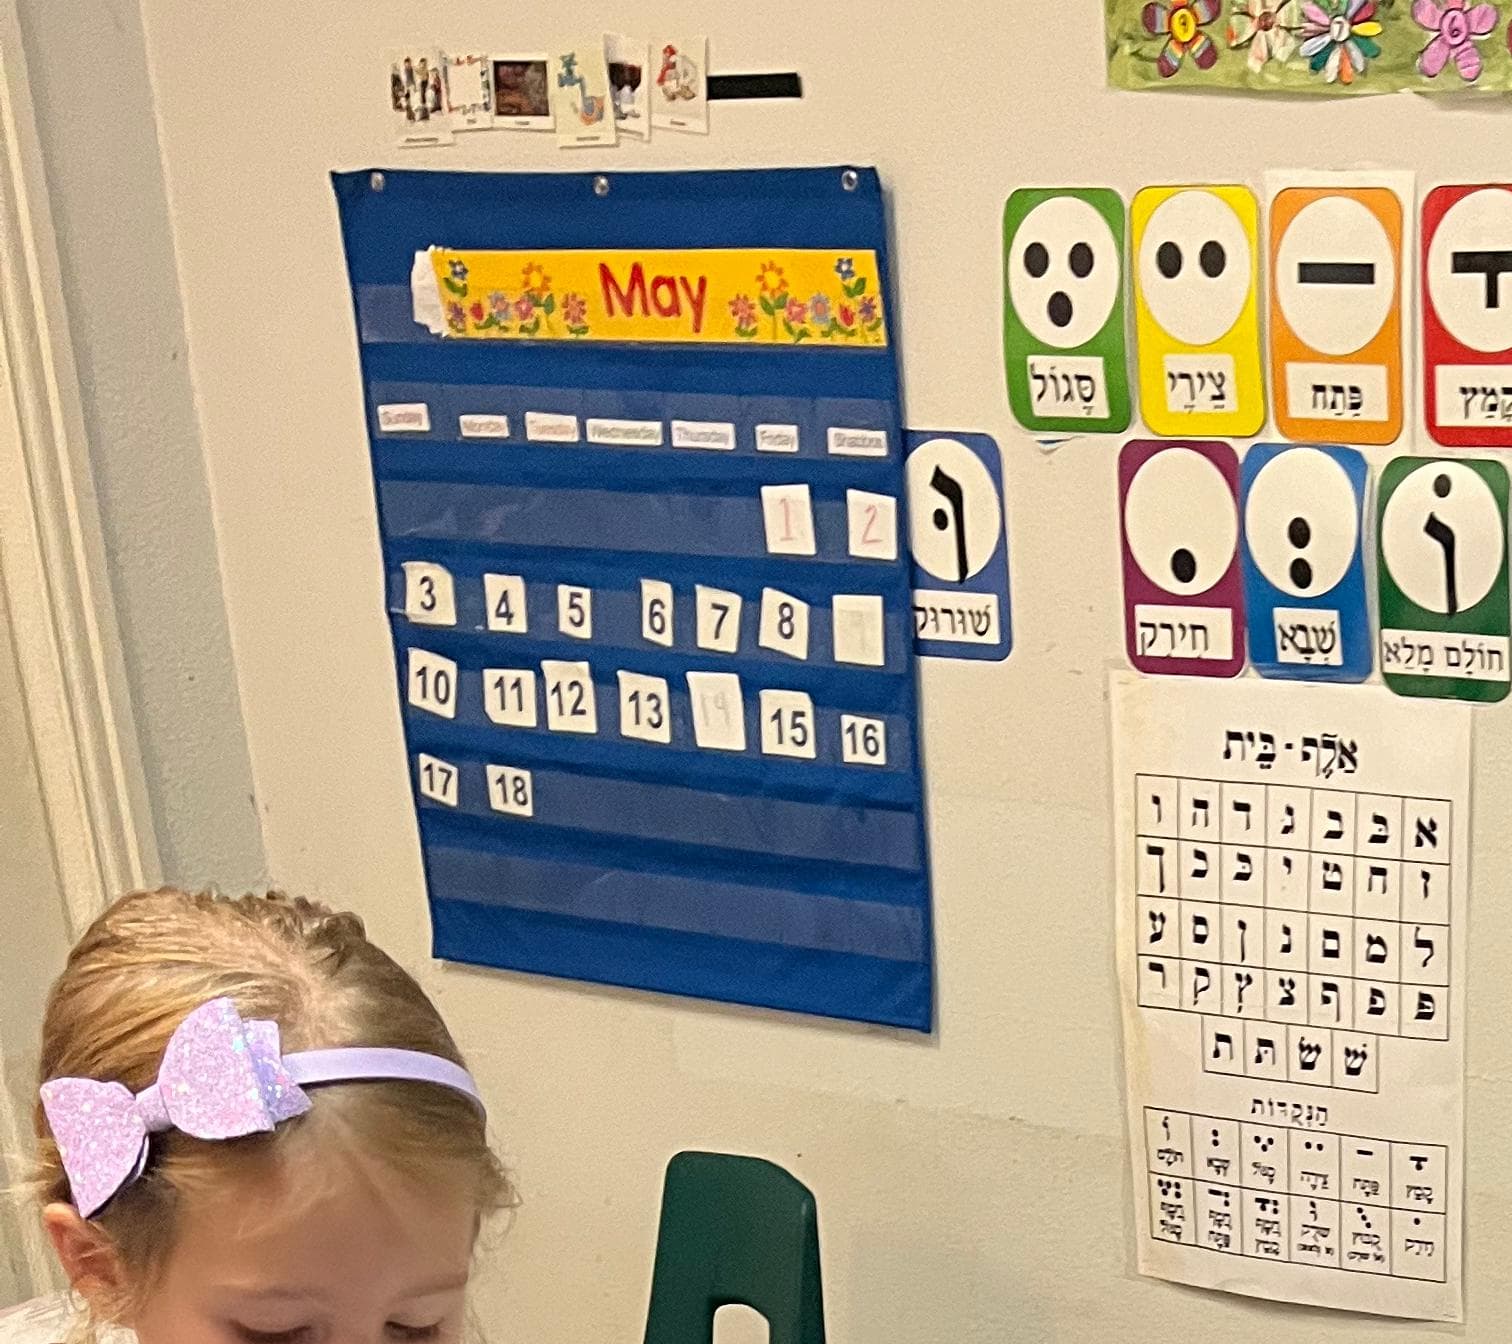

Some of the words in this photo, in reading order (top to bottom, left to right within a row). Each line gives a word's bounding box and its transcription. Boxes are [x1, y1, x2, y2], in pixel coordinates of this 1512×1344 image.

[599, 262, 707, 333] May
[862, 505, 882, 545] 2
[419, 576, 436, 612] 3
[495, 589, 514, 626] 4
[568, 592, 585, 628] 5
[648, 598, 666, 635] 6
[711, 602, 729, 640] 7
[777, 602, 795, 640] 8
[413, 666, 450, 708] 10
[494, 676, 523, 712] 11
[551, 680, 587, 717] 12
[628, 690, 663, 729] 13
[770, 708, 808, 747] 15
[843, 720, 882, 759] 16
[422, 762, 455, 799] 17
[495, 773, 528, 806] 18
